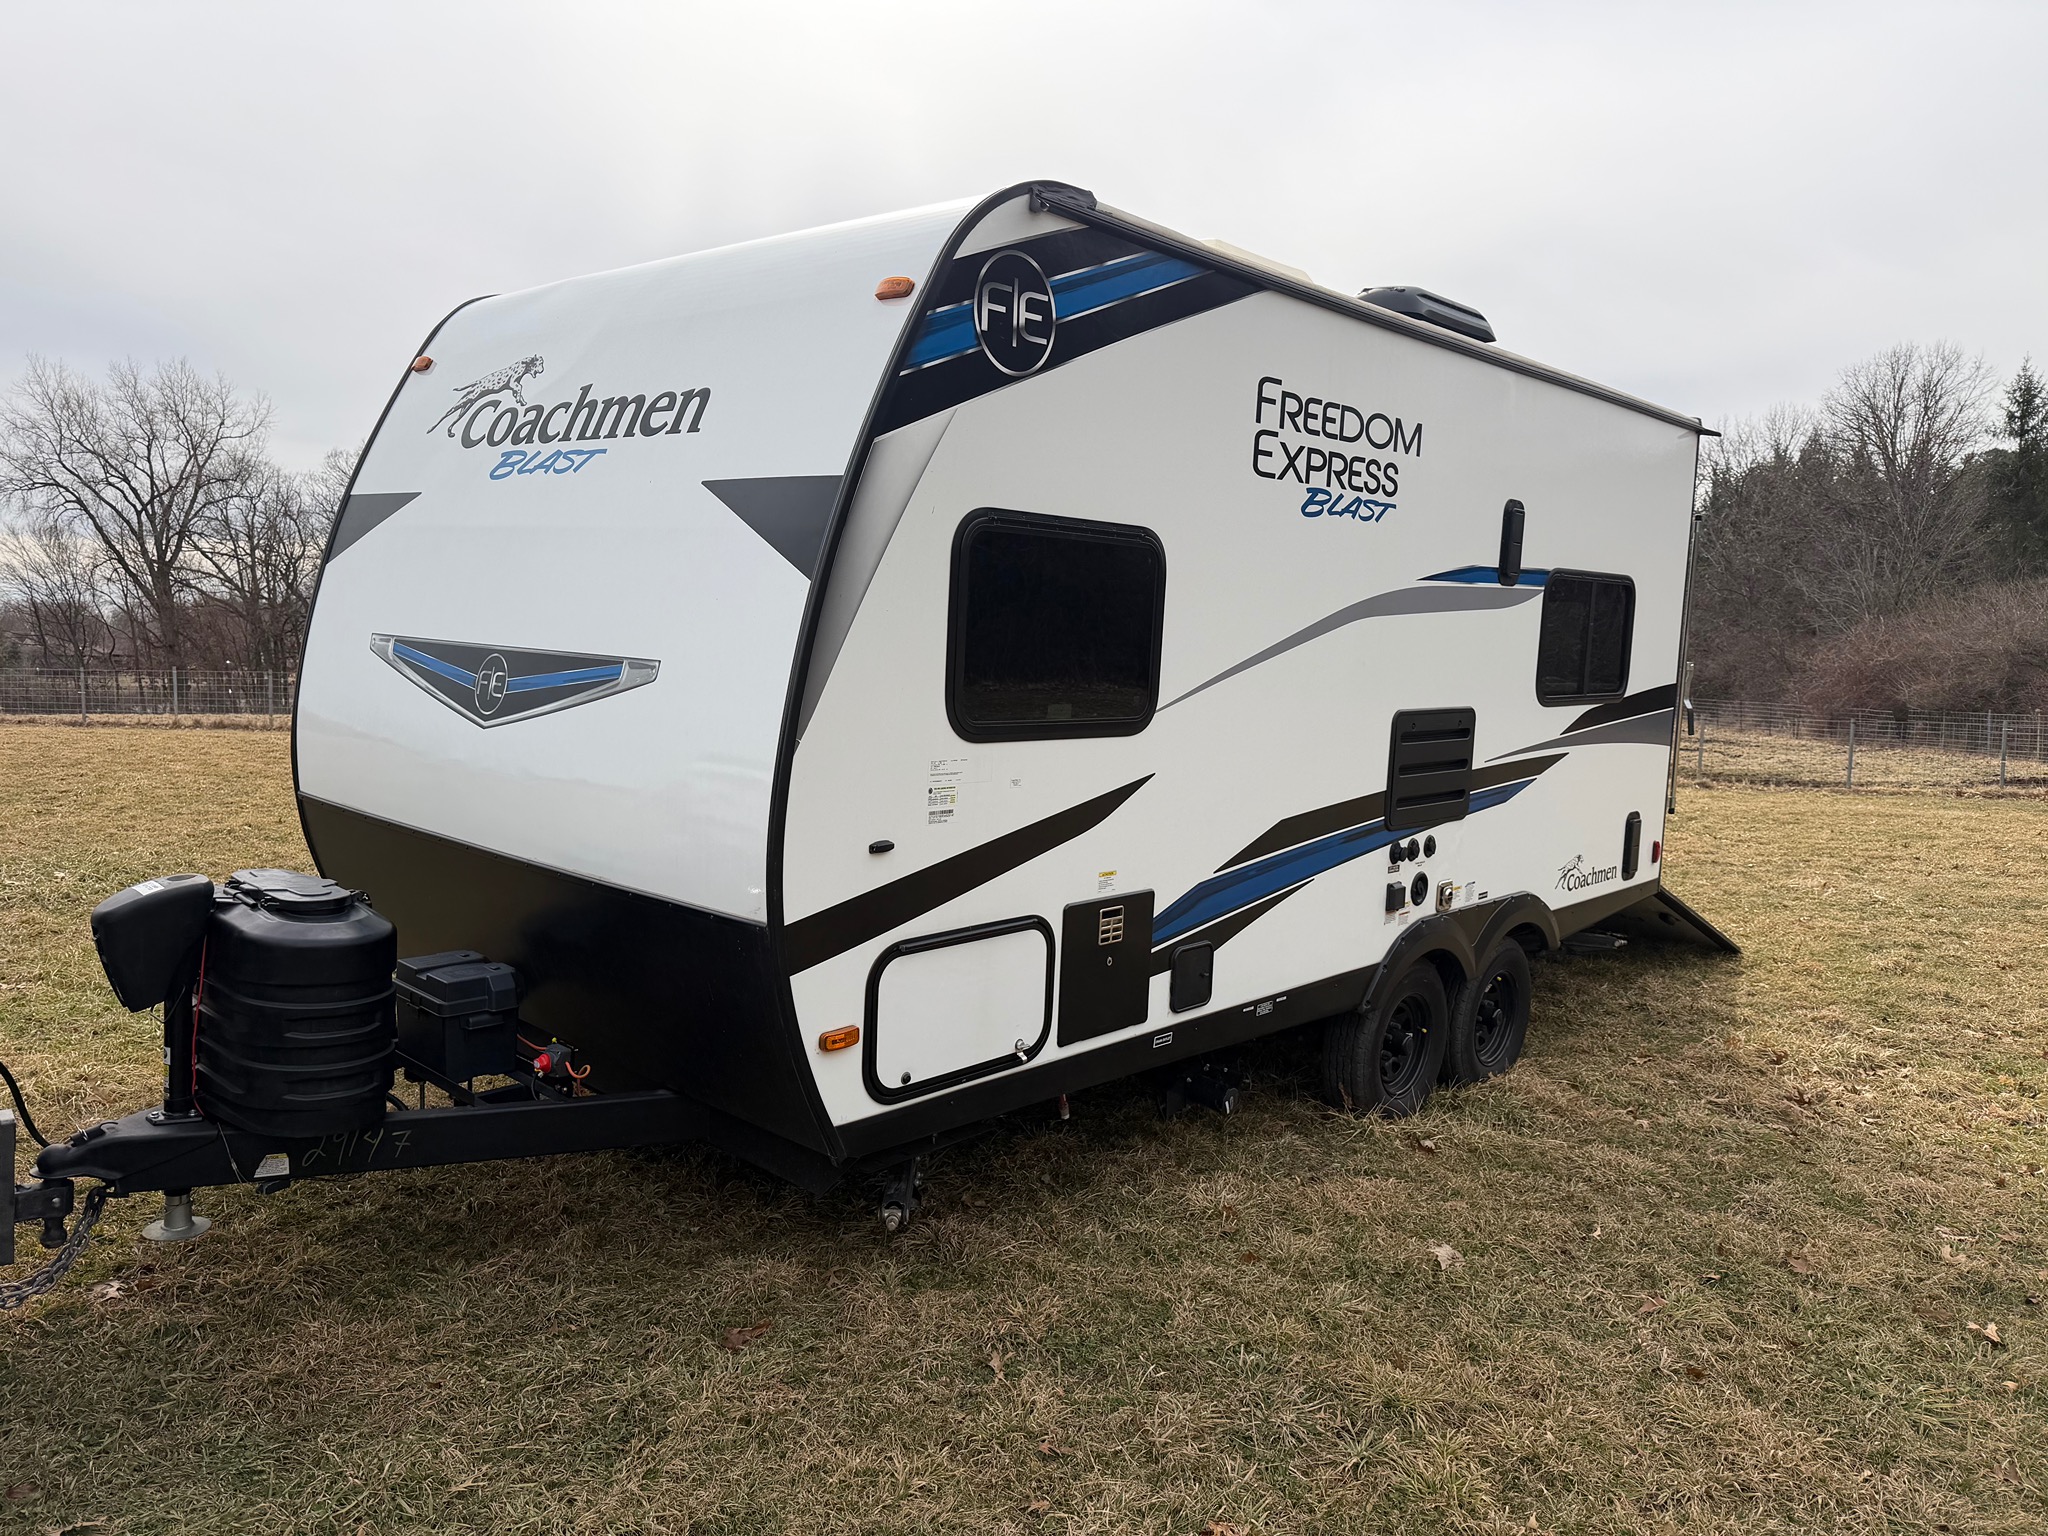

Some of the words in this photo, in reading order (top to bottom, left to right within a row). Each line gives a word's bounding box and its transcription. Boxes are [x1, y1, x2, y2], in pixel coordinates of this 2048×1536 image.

[460, 382, 712, 450] Coachmen
[1255, 375, 1423, 457] FREEDOM
[488, 448, 609, 481] BLAST
[1252, 429, 1400, 498] EXPRESS
[1300, 487, 1397, 523] BLAST
[1567, 865, 1617, 892] Coachmen
